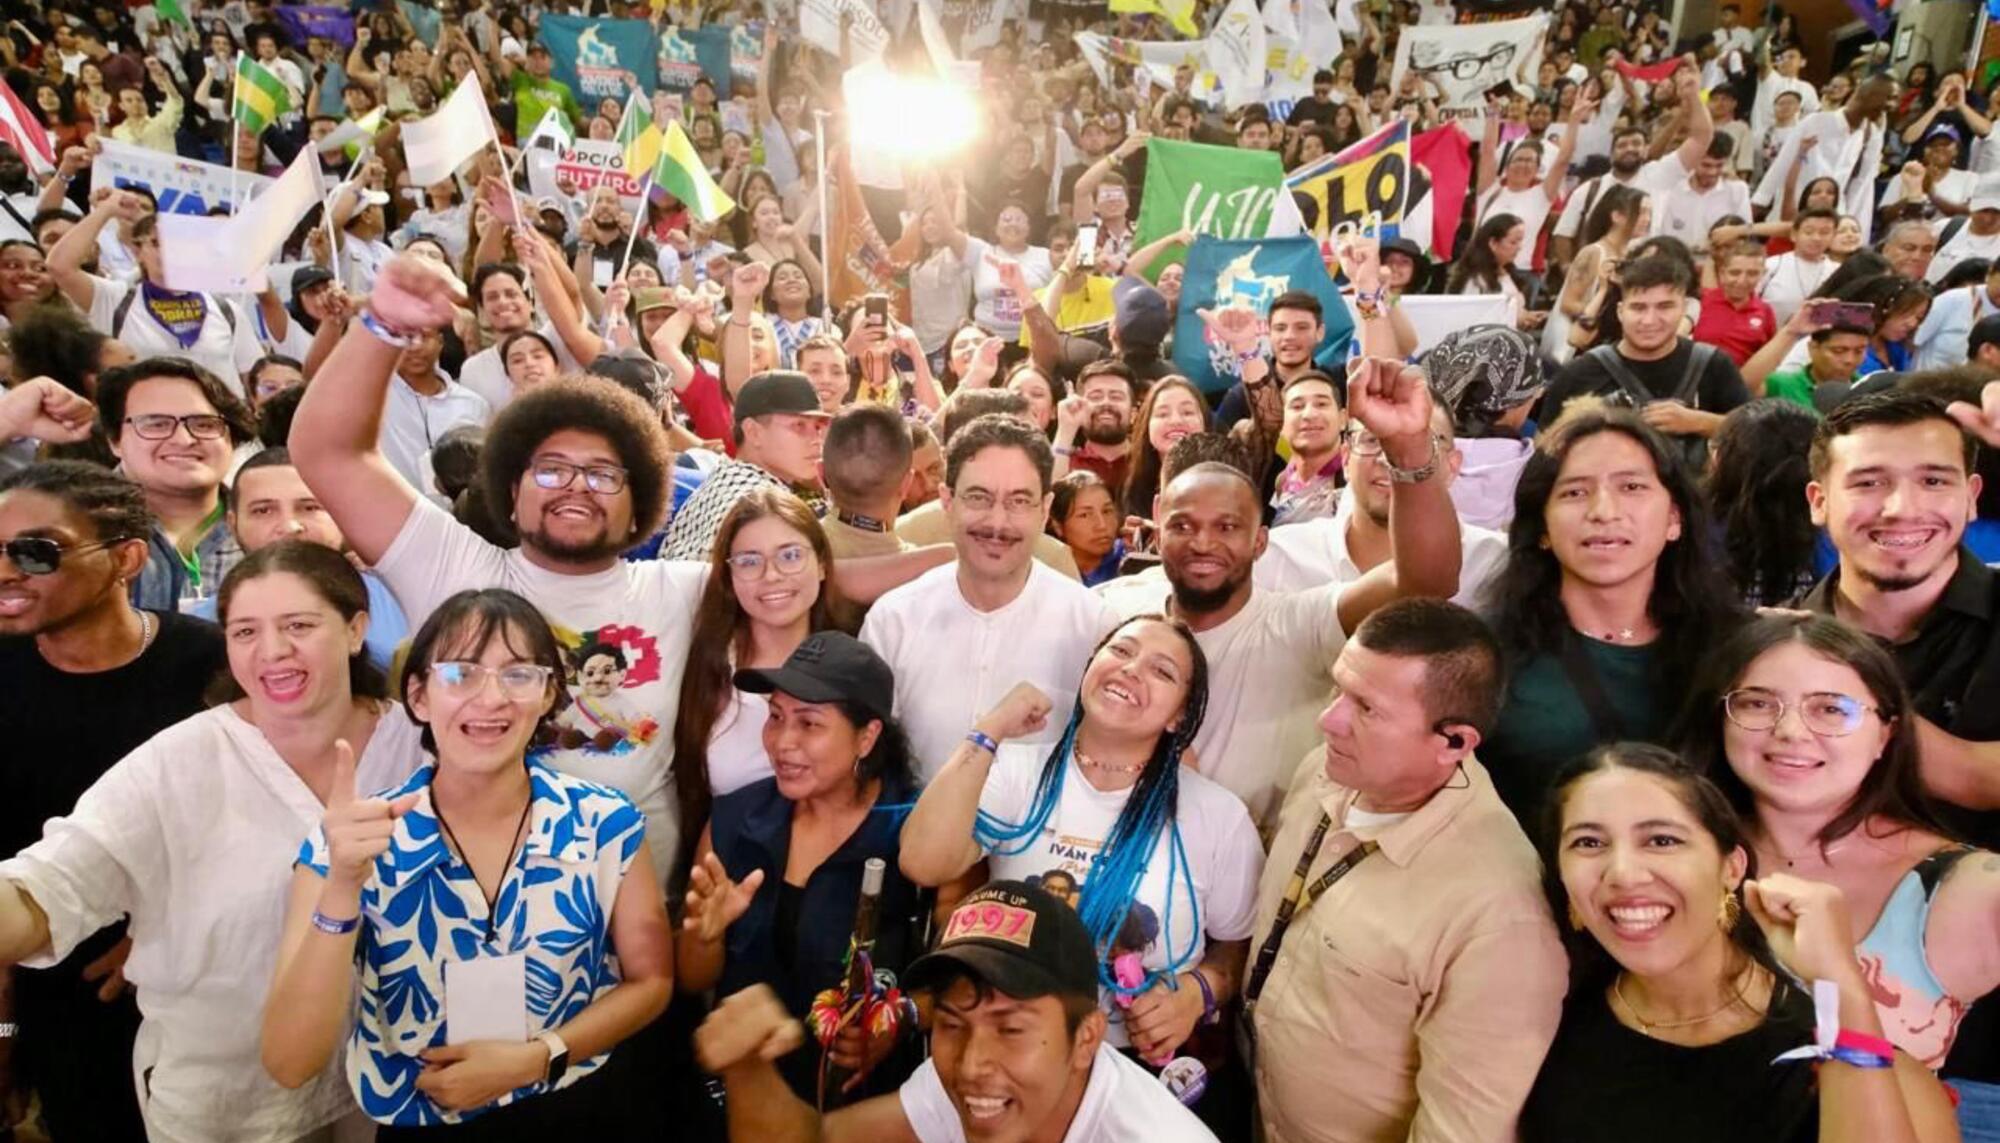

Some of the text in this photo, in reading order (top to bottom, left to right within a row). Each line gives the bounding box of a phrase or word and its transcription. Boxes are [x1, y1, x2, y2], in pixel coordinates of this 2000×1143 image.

[564, 148, 624, 169] OPCIÓ
[1049, 842, 1087, 862] IVÁN
[1010, 894, 1029, 906] UP
[947, 906, 1028, 938] 1997
